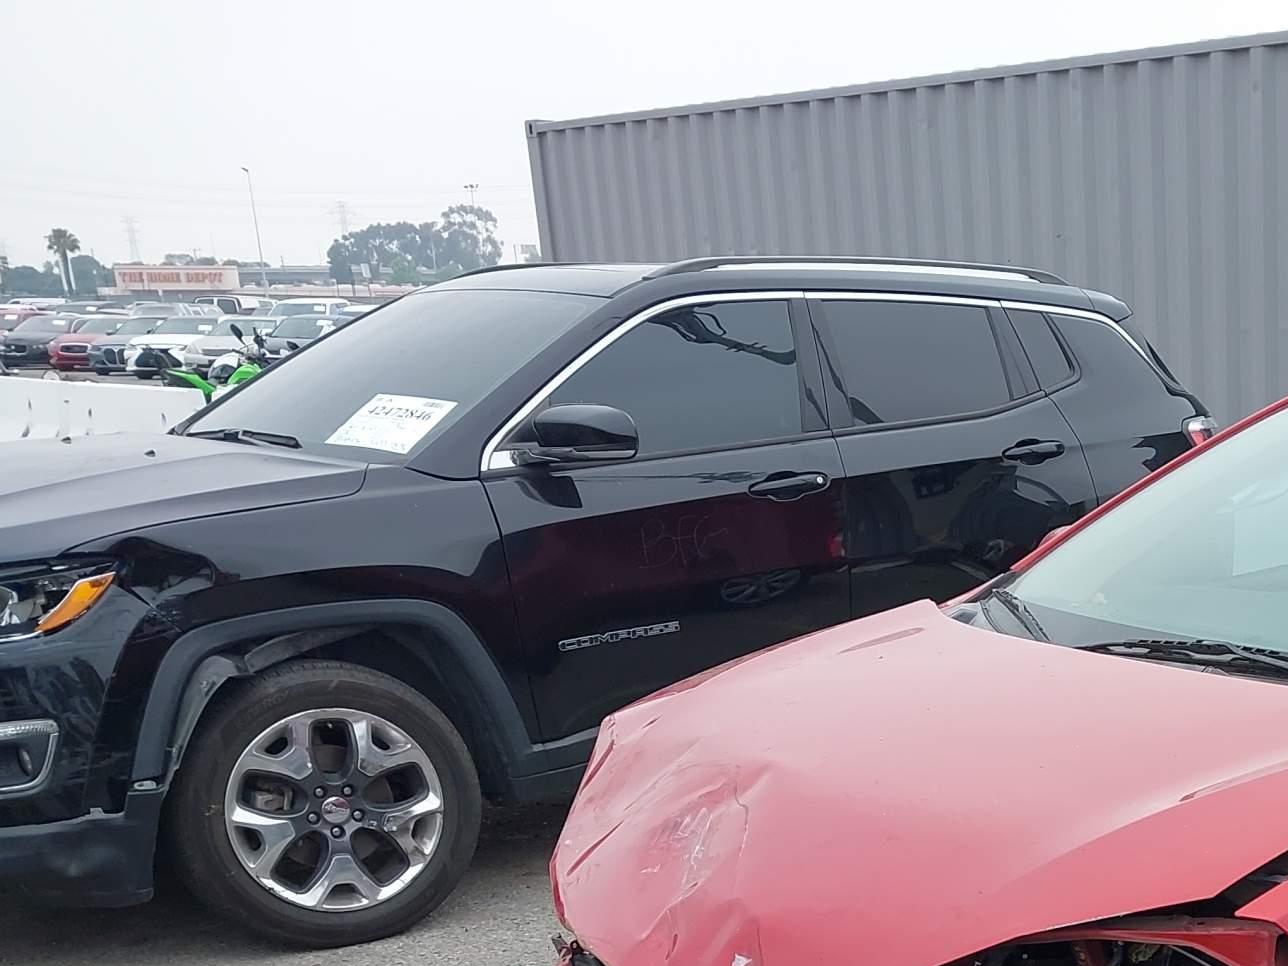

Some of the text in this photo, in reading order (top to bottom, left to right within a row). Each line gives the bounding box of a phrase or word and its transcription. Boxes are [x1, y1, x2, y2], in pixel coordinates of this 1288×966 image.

[119, 271, 224, 283] THE HOME DEPOT
[367, 405, 435, 422] 42472846
[557, 620, 681, 652] COMPASS
